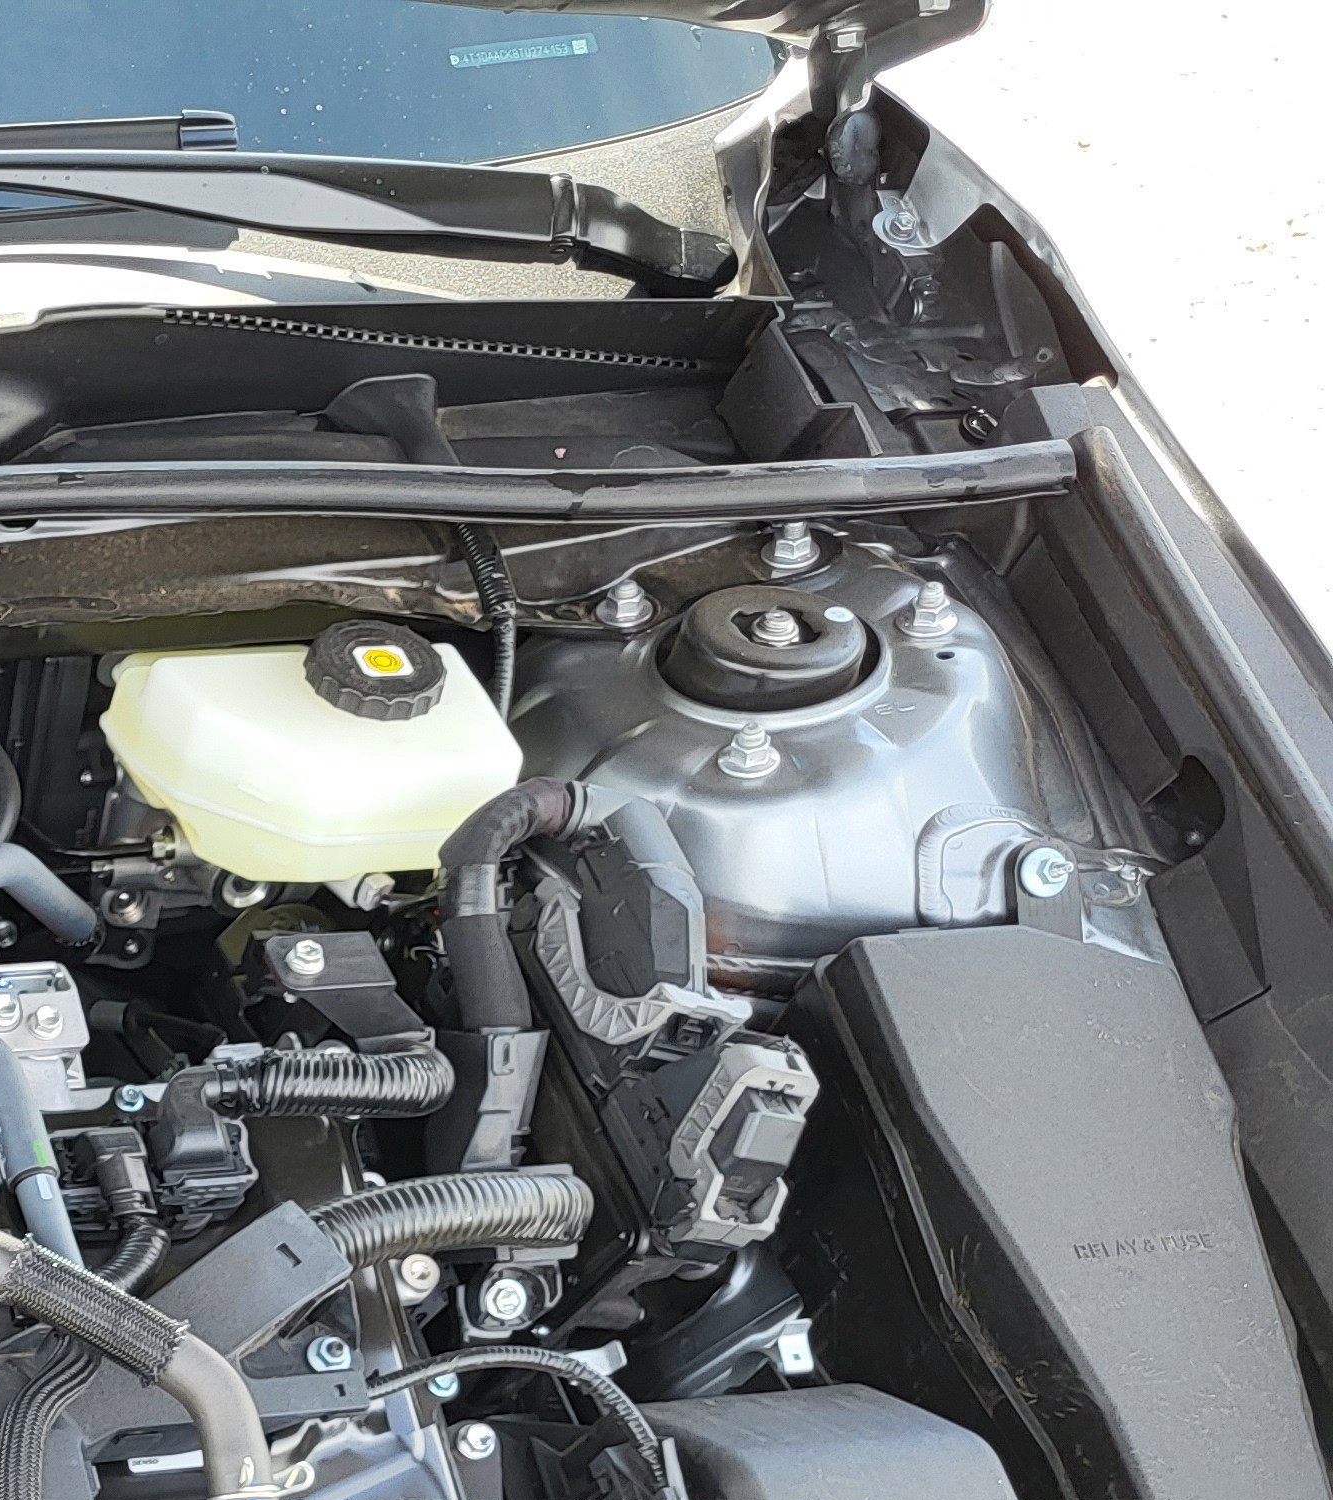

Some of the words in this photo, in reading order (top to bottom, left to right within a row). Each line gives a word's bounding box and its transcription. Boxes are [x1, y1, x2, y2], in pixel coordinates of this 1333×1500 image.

[1072, 1238, 1138, 1260] RELAY
[1143, 1237, 1155, 1253] &
[1160, 1232, 1215, 1252] FUSE
